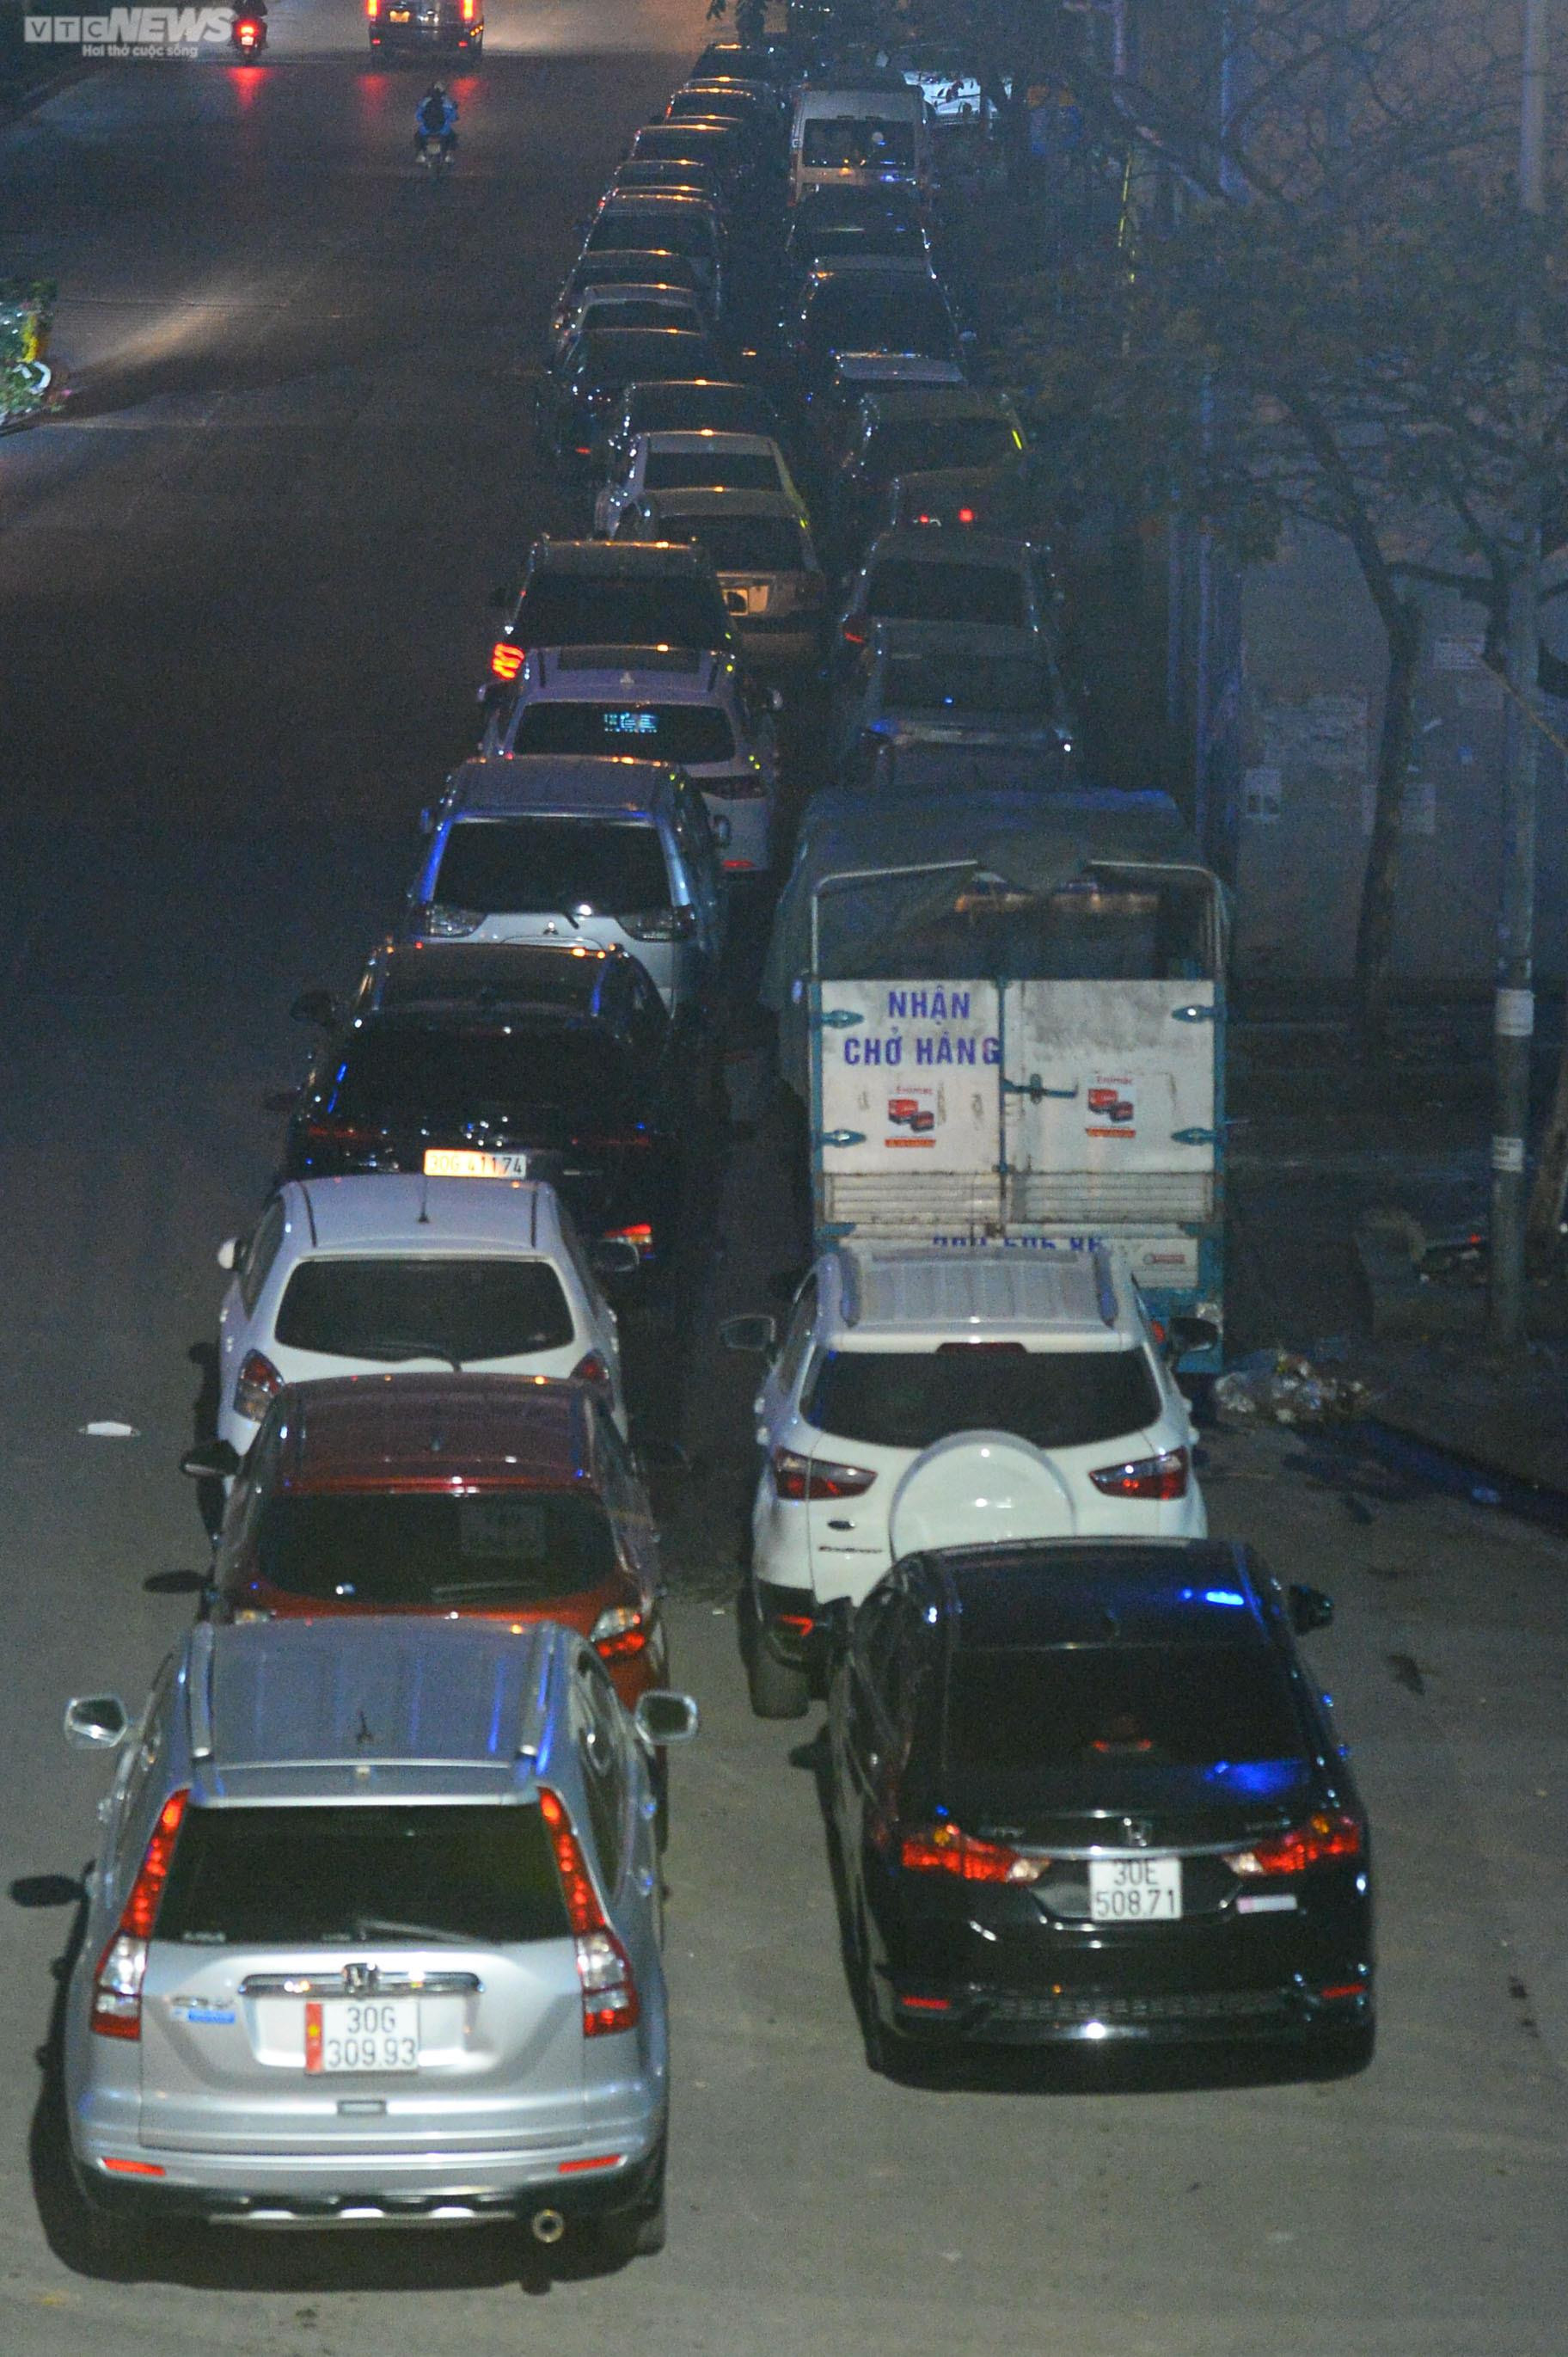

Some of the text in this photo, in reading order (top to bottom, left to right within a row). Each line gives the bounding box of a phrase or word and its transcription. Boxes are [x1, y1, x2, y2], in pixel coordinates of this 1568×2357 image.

[888, 985, 970, 1025] NHẬN
[844, 1026, 902, 1065] CHỞ
[1114, 1859, 1159, 1886] 30E
[347, 2005, 395, 2034] 30G
